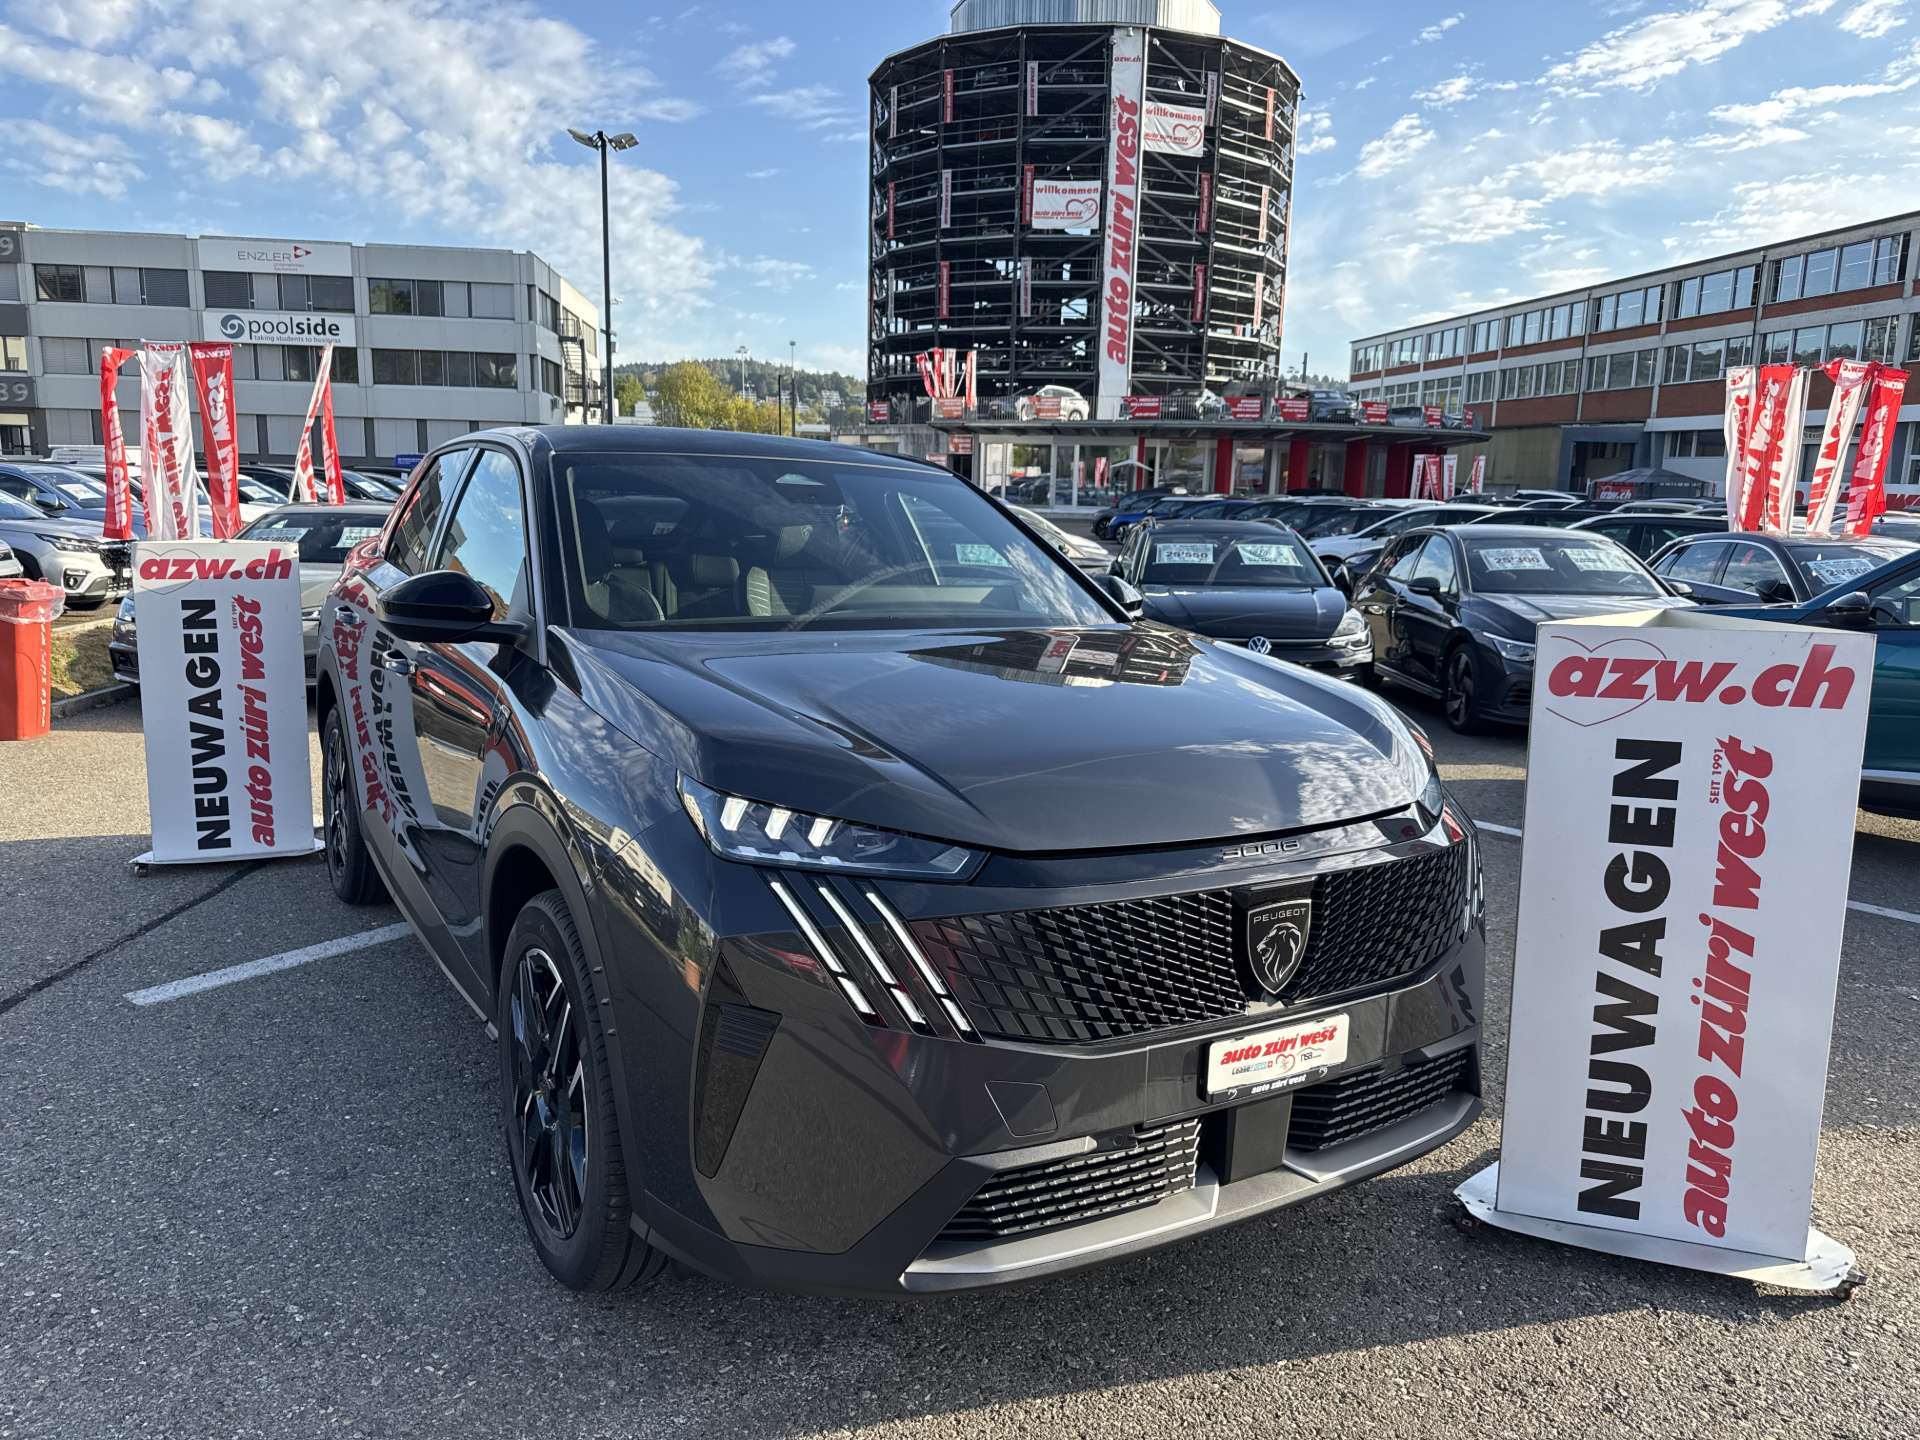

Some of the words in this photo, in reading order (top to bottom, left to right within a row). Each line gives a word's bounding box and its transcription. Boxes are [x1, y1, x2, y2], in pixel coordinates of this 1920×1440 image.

[1114, 94, 1139, 186] west
[1145, 106, 1203, 122] willkommen
[1035, 185, 1099, 195] willkommen
[237, 250, 292, 263] ENZLER
[1107, 189, 1135, 276] züri
[248, 316, 340, 340] poolside
[254, 335, 275, 343] taking
[1104, 277, 1130, 366] auto
[139, 548, 292, 580] azw.ch
[231, 594, 265, 681] west
[1547, 643, 1856, 710] azw.ch
[180, 599, 232, 850] NEUWAGEN
[236, 684, 271, 764] züri
[1709, 779, 1721, 804] SEIT
[1711, 748, 1724, 776] 1991
[243, 766, 276, 847] auto
[1712, 735, 1774, 911] west
[1253, 907, 1307, 923] PEUGEOT
[1577, 737, 1683, 1221] NEUWAGEN
[1689, 912, 1756, 1079] züri
[1220, 1044, 1263, 1066] auto
[1263, 1033, 1300, 1057] züri
[1300, 1024, 1338, 1047] west
[1251, 1083, 1270, 1094] auto
[1270, 1079, 1287, 1090] züri
[1288, 1074, 1307, 1085] west
[1680, 1074, 1741, 1239] auto
